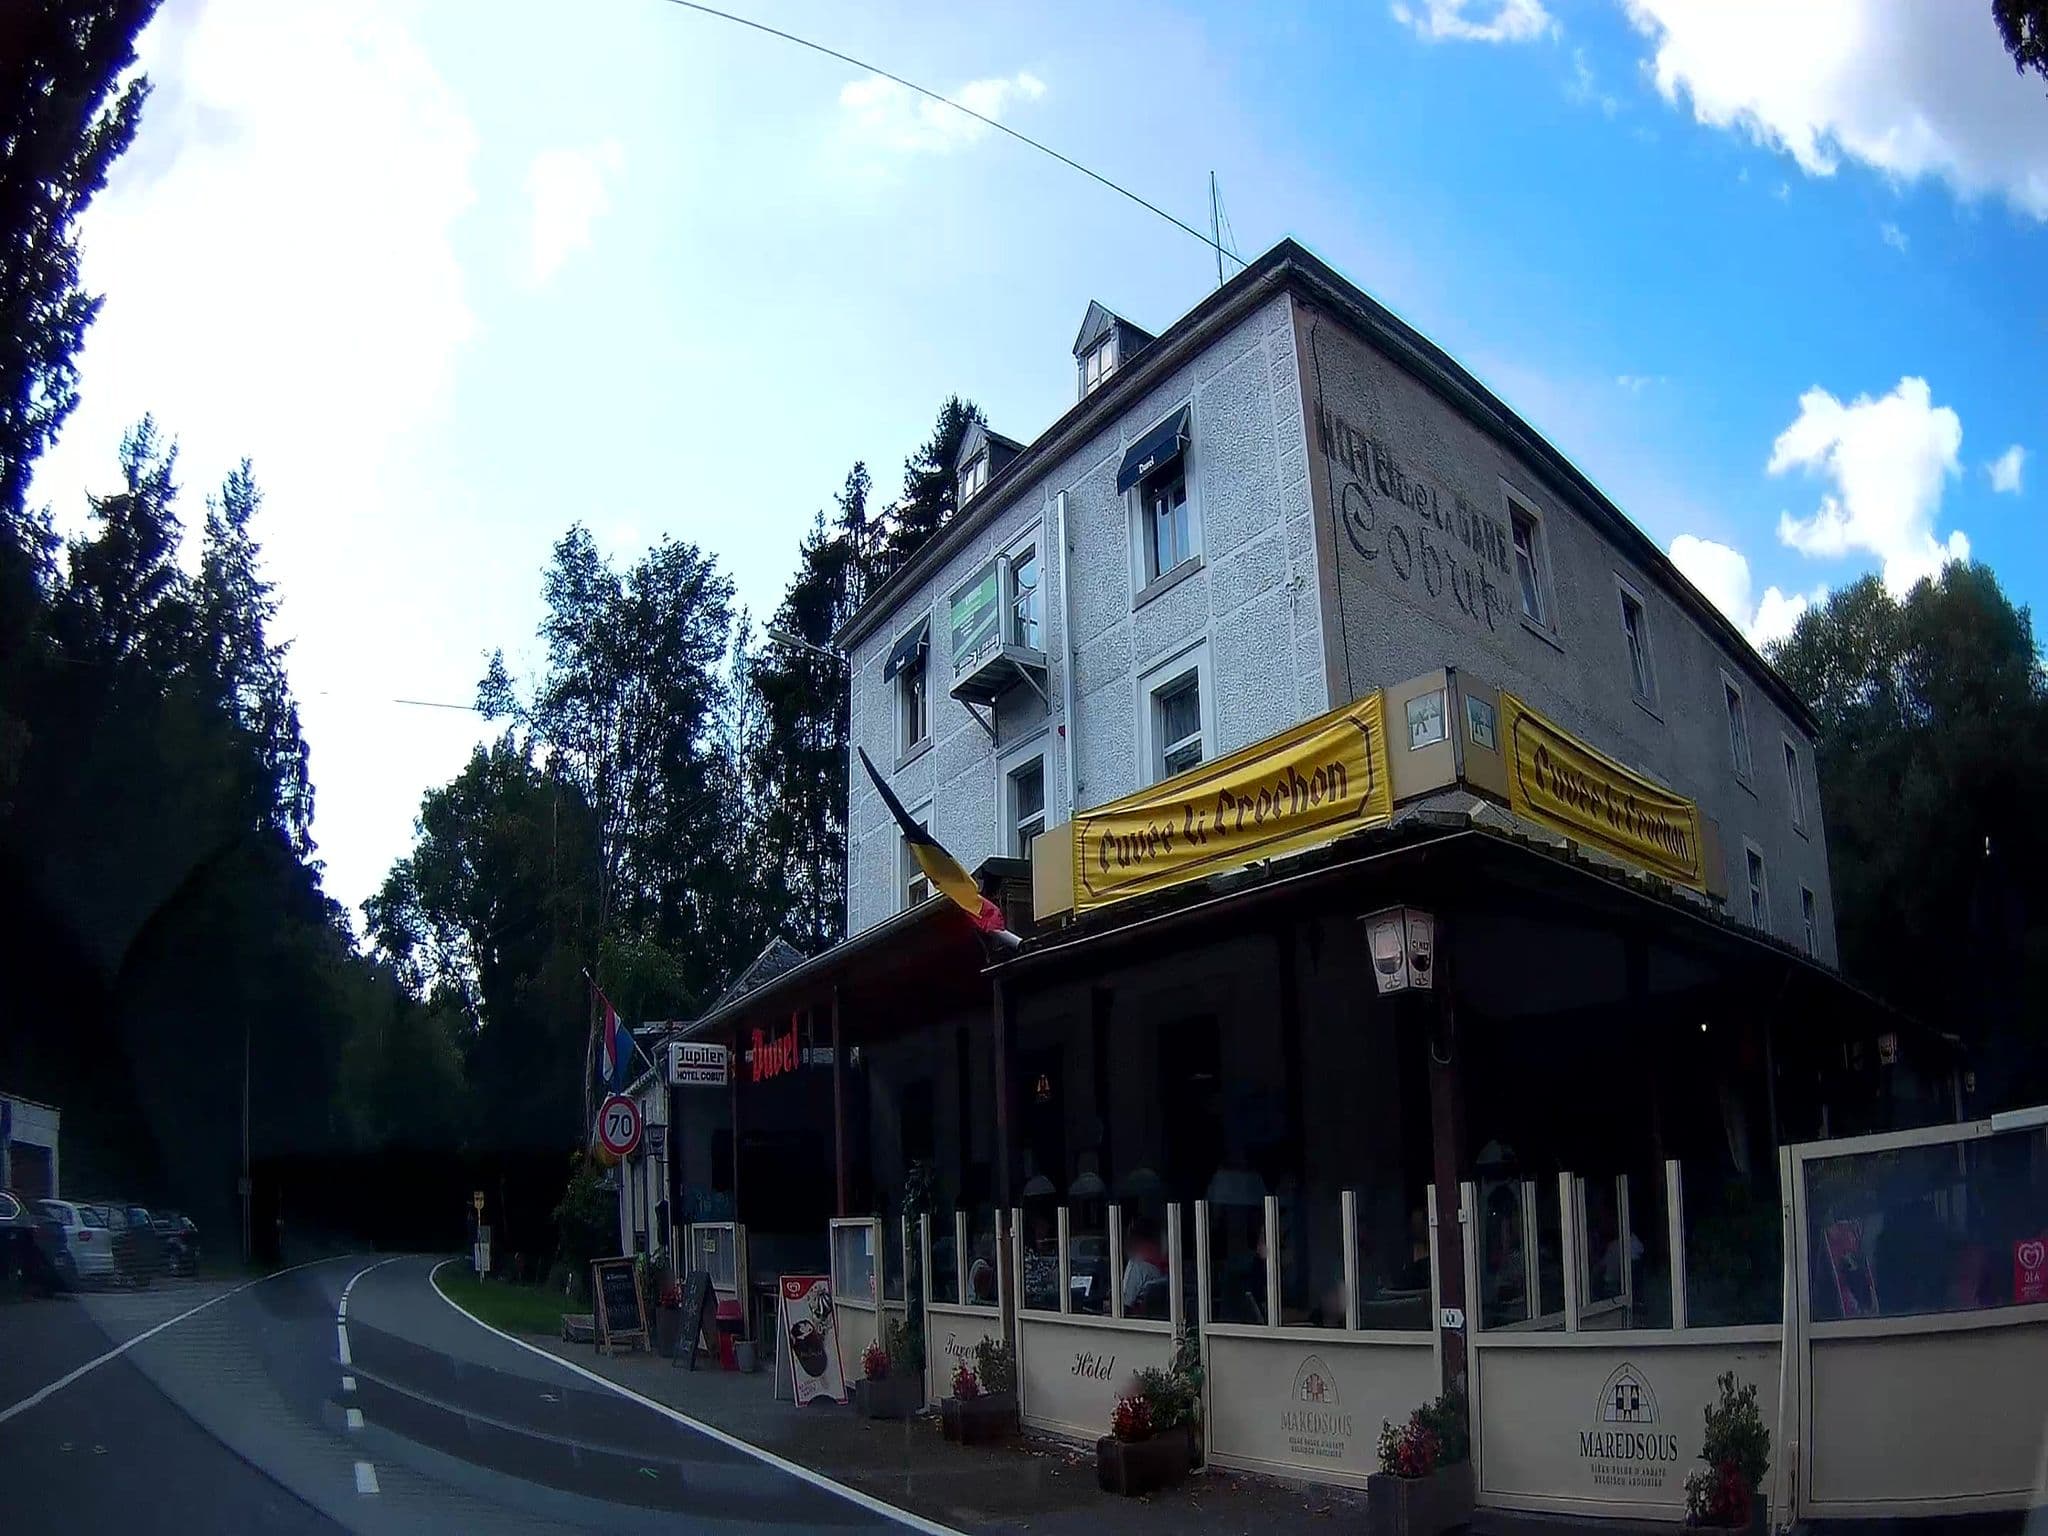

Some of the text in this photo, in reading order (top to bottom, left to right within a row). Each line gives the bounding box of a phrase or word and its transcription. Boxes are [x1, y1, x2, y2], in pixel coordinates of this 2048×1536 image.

[1213, 760, 1349, 837] Crochon
[678, 1046, 724, 1065] Jupiler
[752, 1010, 799, 1084] Duvel
[677, 1070, 725, 1082] HOTEL COBUT
[608, 1114, 632, 1138] 70
[1579, 1431, 1678, 1462] MAREDSOUS
